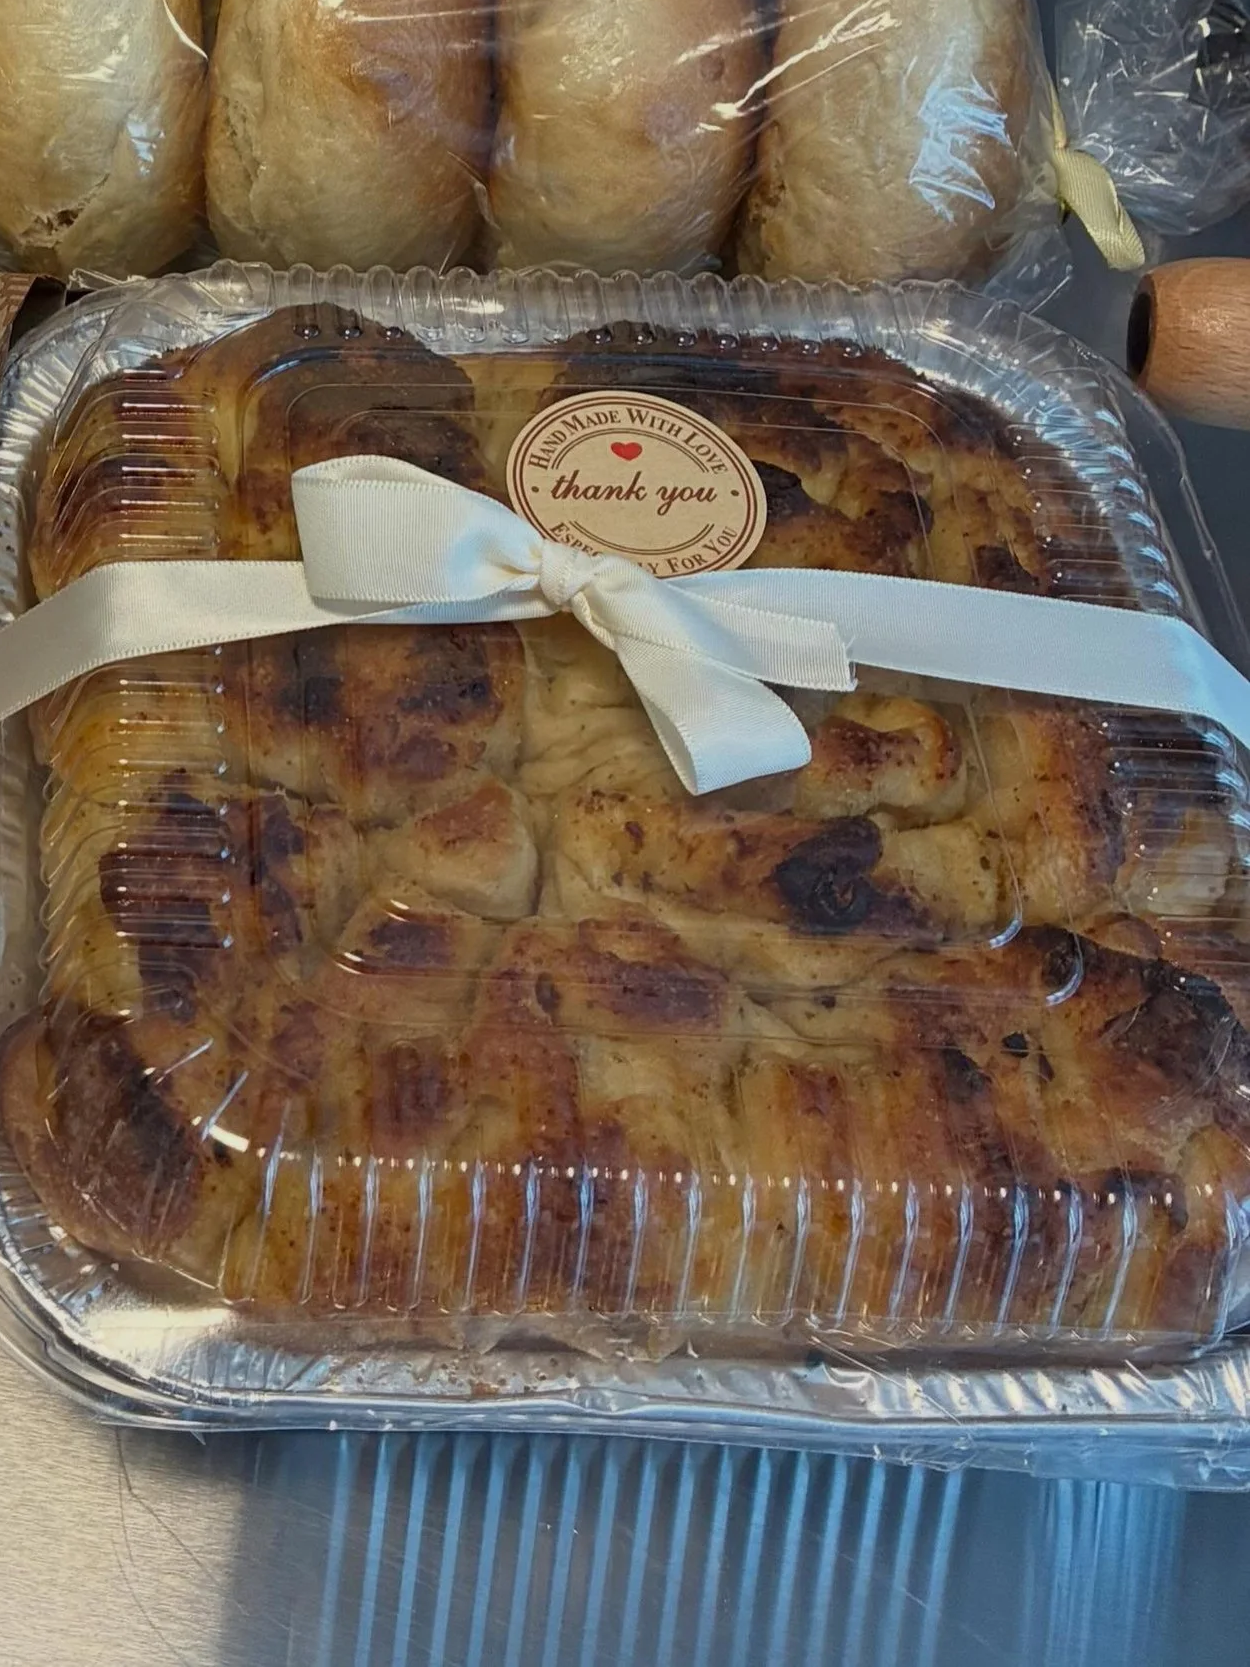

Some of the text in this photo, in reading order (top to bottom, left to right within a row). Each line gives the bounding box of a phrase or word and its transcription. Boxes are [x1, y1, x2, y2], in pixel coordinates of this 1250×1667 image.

[550, 469, 718, 517] thank you
[664, 553, 710, 574] FOR
[702, 525, 738, 557] YOU
